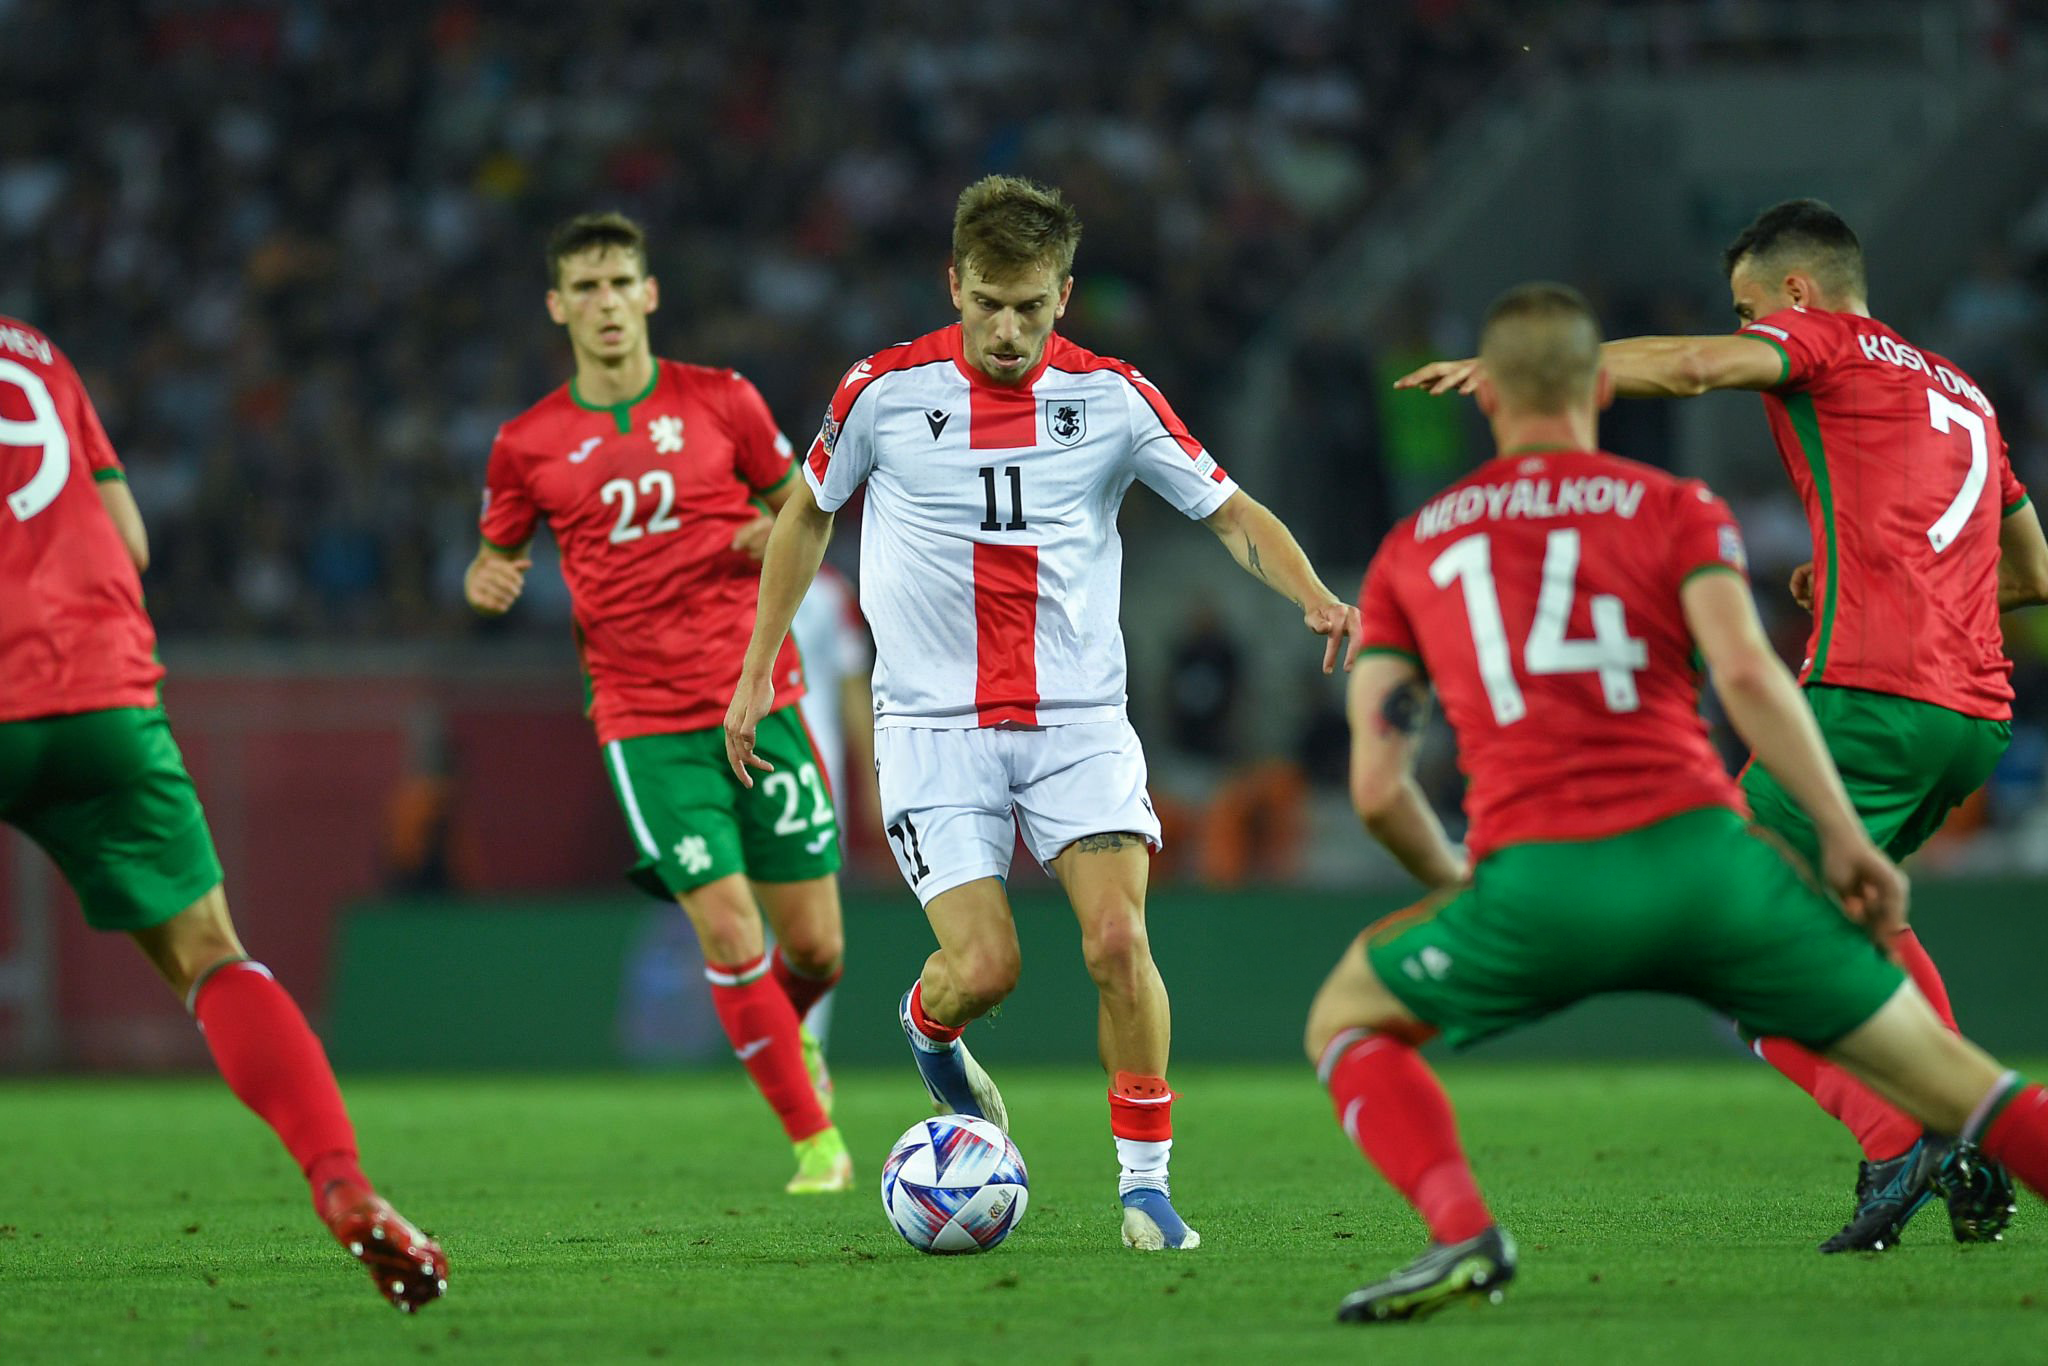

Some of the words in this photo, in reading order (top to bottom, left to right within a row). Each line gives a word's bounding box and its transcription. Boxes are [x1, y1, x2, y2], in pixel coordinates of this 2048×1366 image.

[0, 357, 70, 521] 9
[1926, 388, 1989, 554] 7
[601, 470, 682, 544] 22
[978, 466, 1027, 532] 11
[1413, 475, 1646, 542] NEDYALKOV
[1428, 527, 1649, 726] 14
[763, 762, 835, 836] 22
[887, 812, 930, 888] 11
